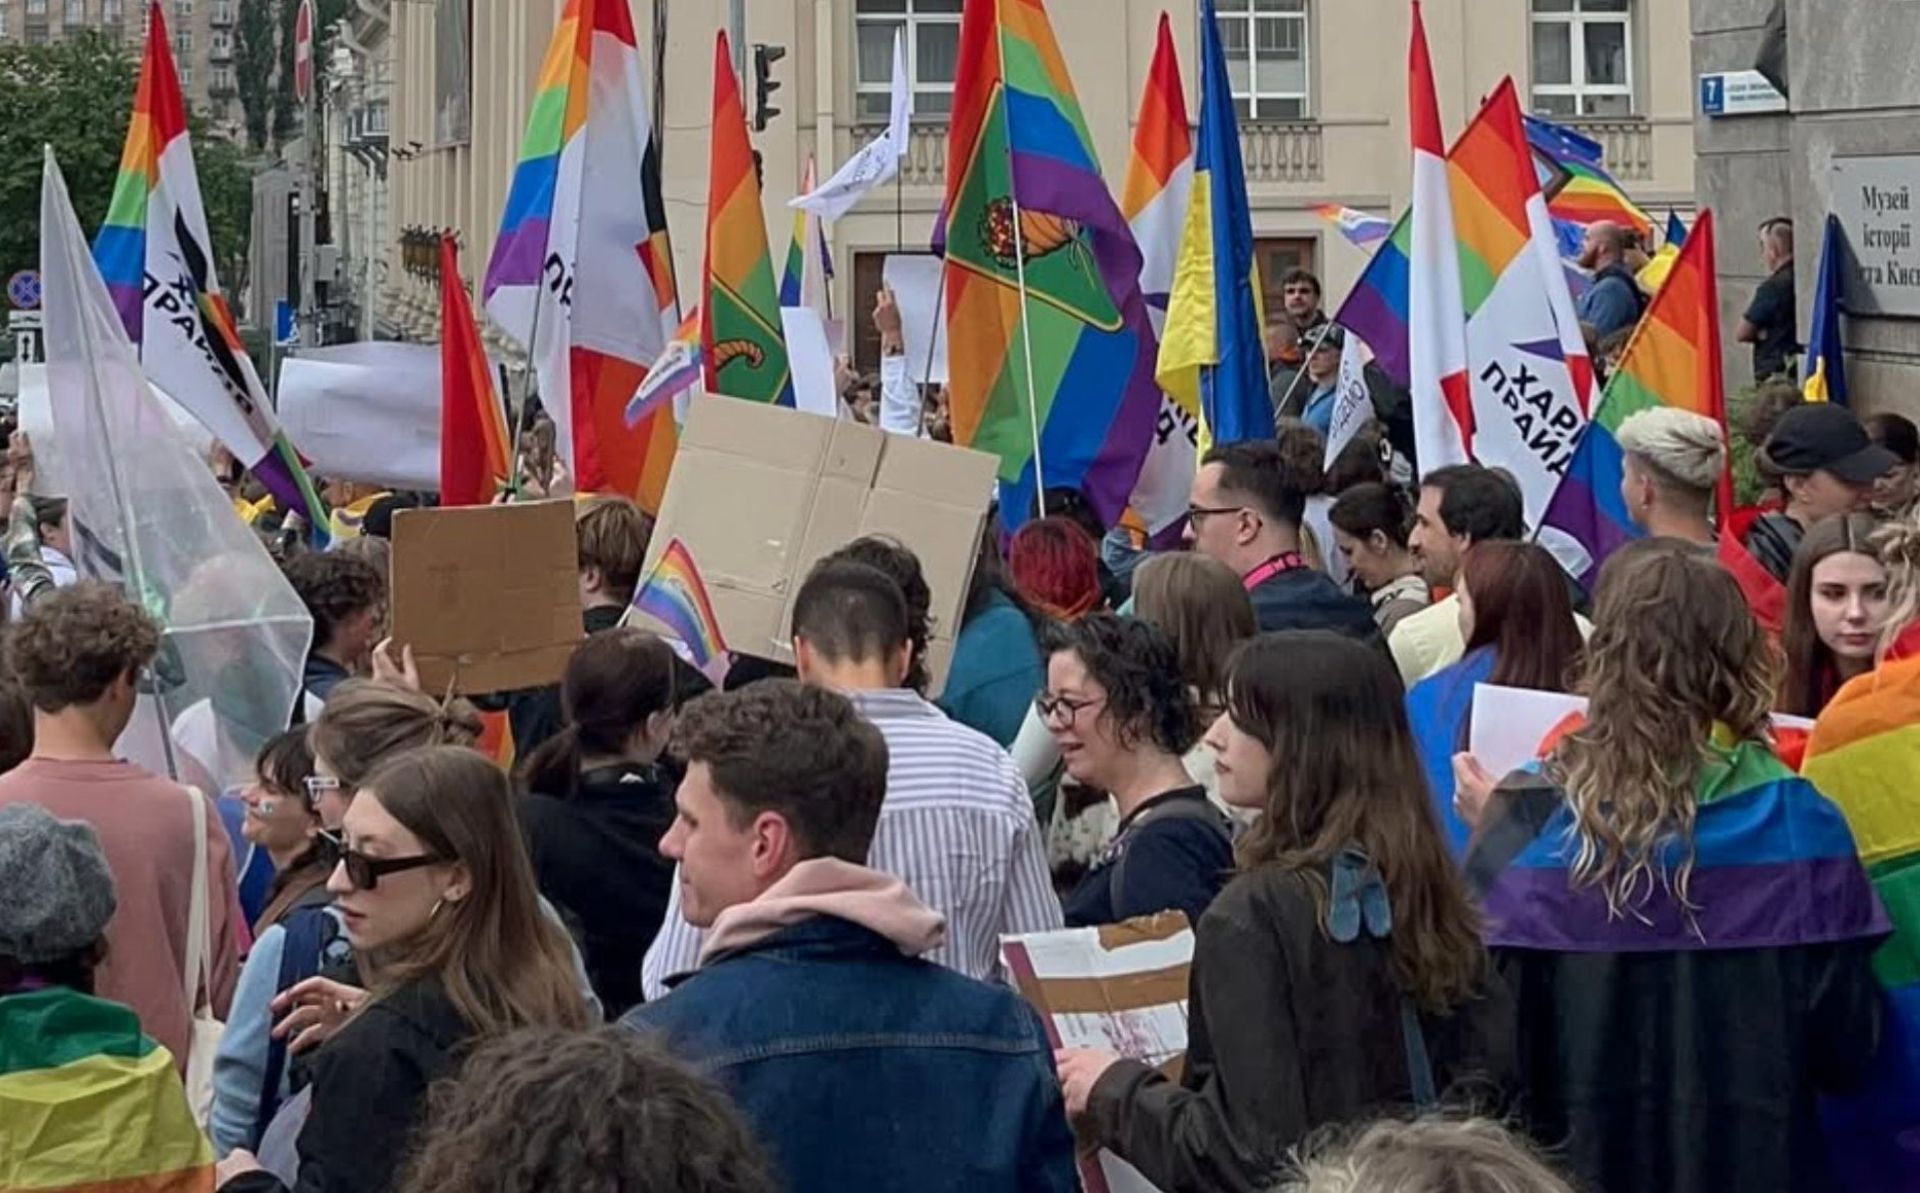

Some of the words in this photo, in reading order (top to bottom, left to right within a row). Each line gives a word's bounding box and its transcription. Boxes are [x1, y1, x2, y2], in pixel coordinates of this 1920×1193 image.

[1707, 81, 1717, 102] 7
[1862, 185, 1909, 217] Музей
[1863, 223, 1911, 255] історії
